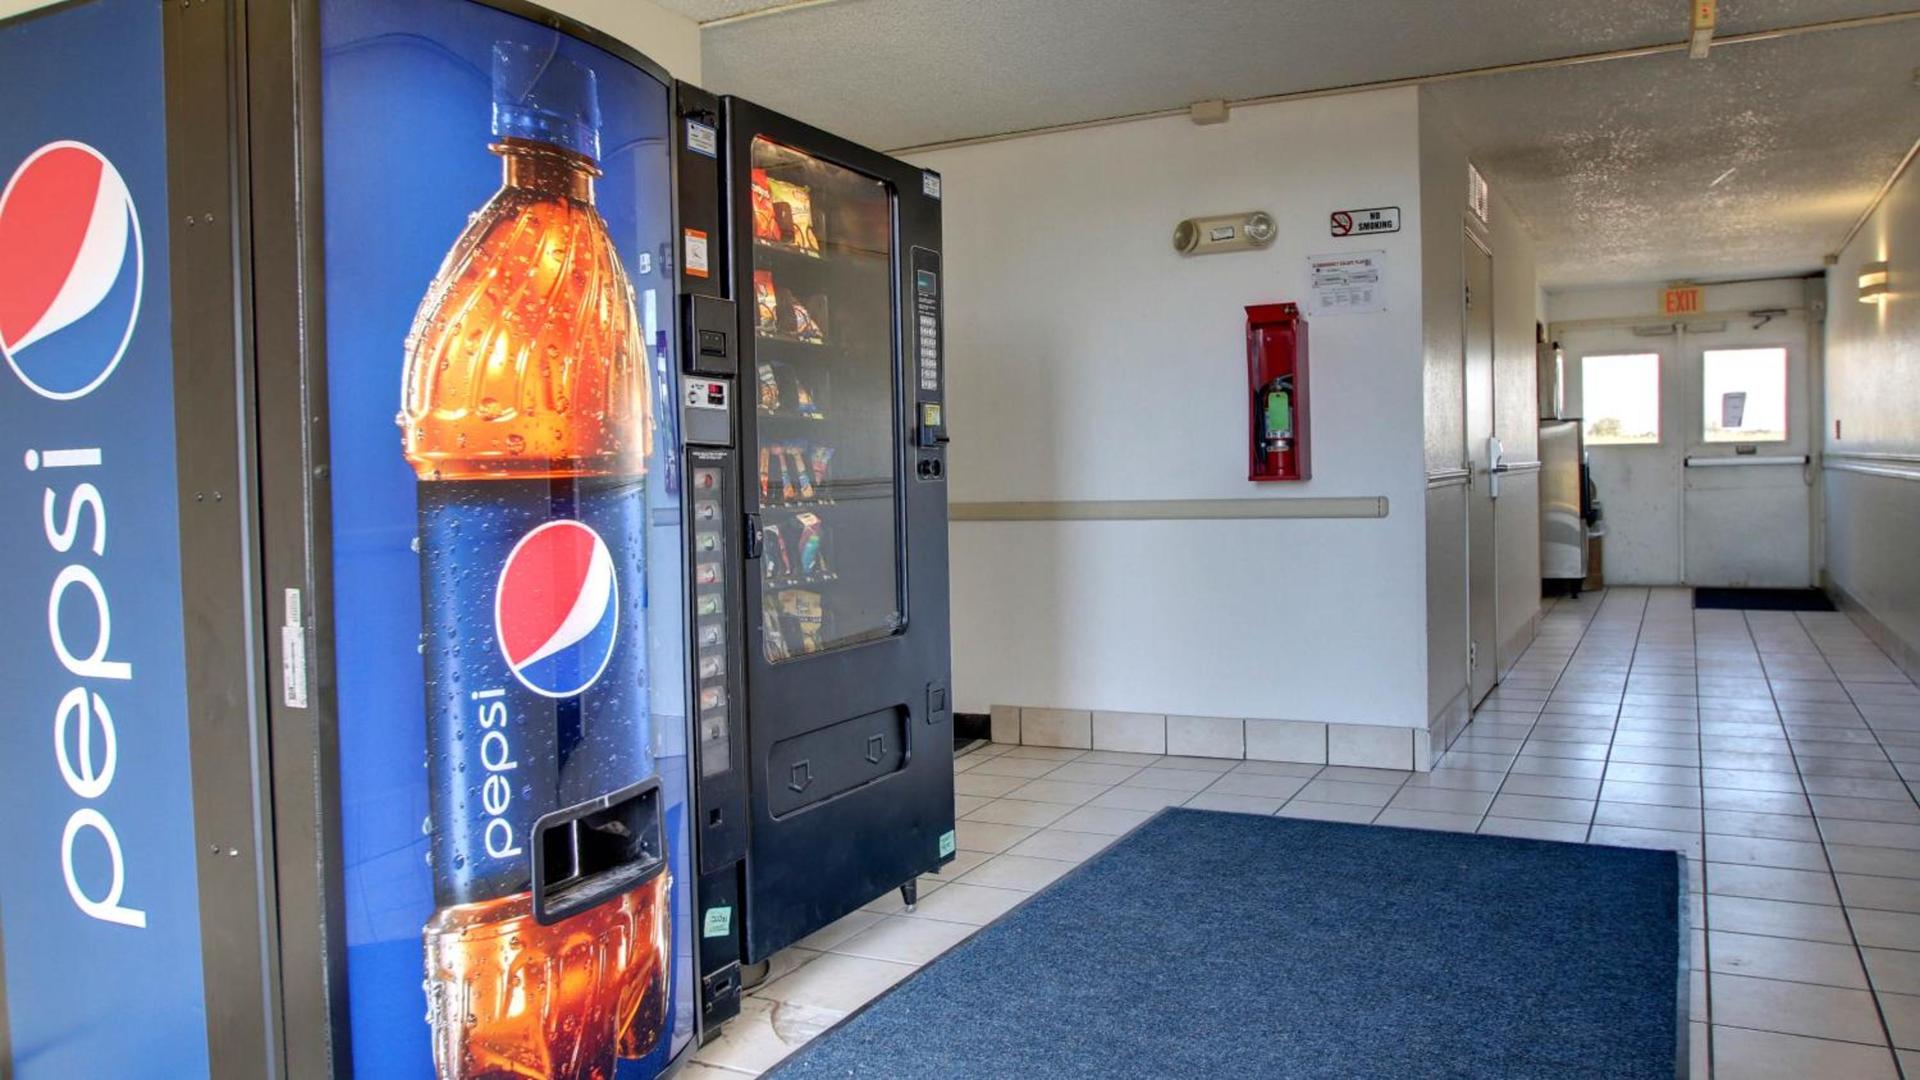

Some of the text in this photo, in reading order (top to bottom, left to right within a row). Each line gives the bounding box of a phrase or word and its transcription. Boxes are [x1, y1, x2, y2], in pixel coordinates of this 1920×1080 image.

[1358, 220, 1393, 231] SMOKING
[1370, 212, 1381, 220] NO
[1666, 289, 1698, 312] EXIT
[23, 447, 147, 929] pepsi
[471, 688, 522, 859] pepsi
